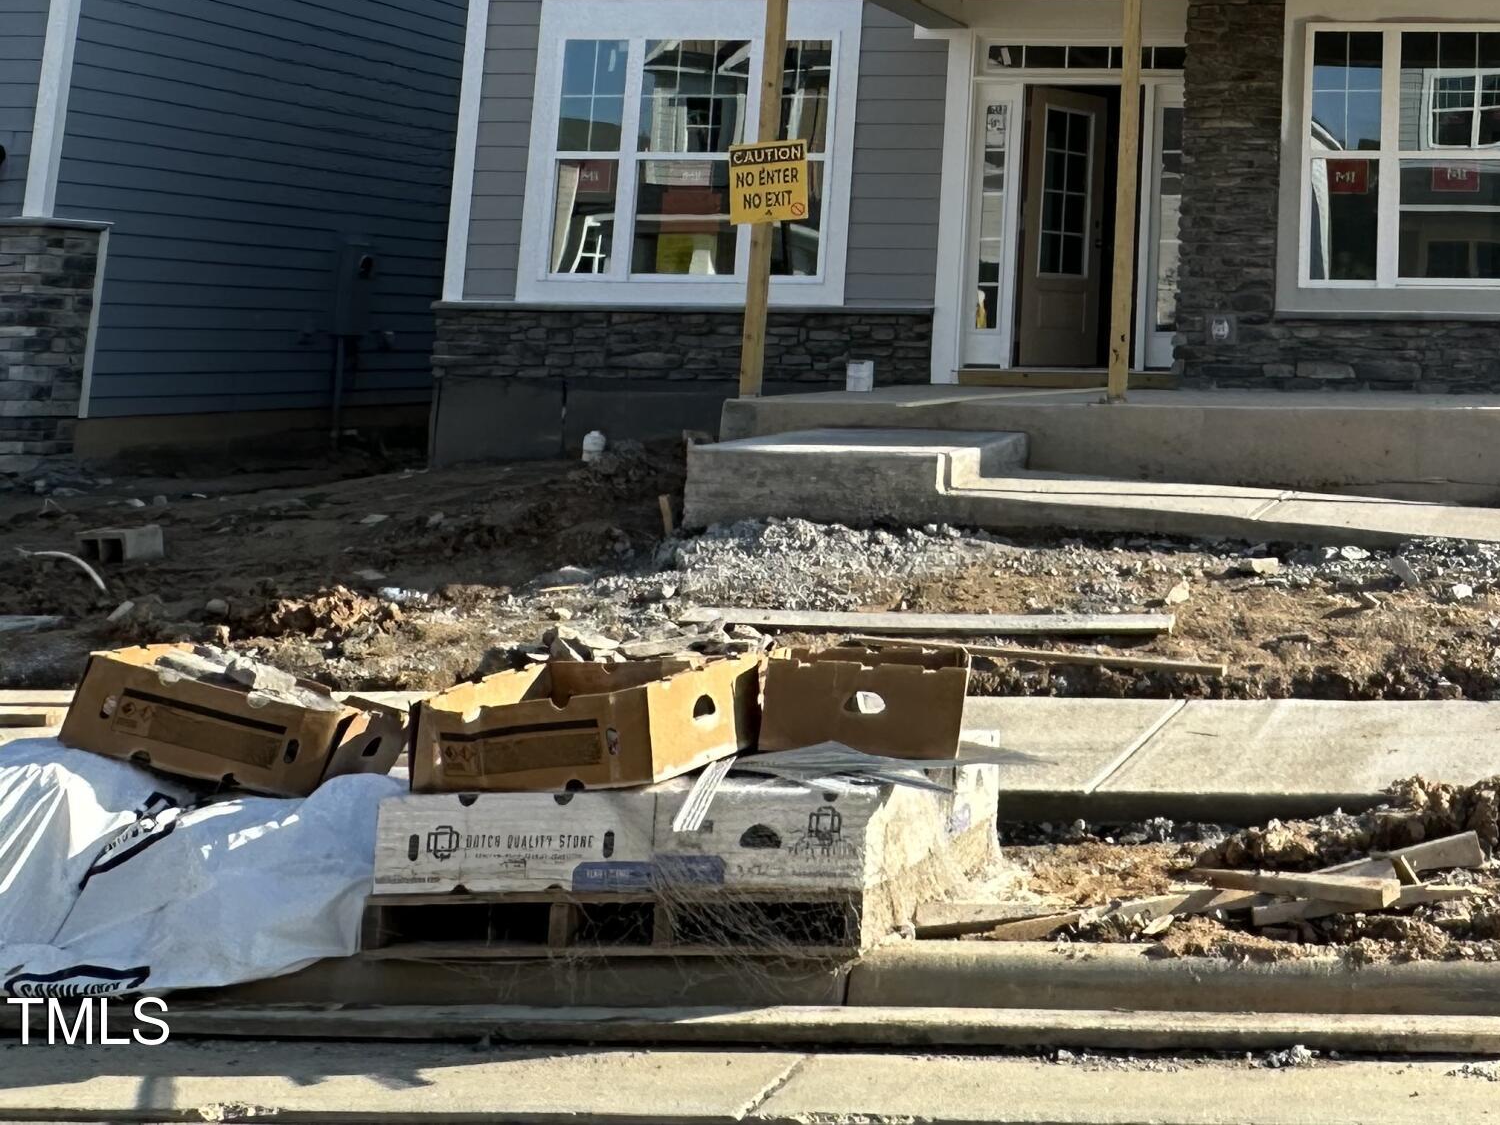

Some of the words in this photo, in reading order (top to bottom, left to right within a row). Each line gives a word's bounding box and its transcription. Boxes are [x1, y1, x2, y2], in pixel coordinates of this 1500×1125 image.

[733, 145, 802, 164] CAUTION
[736, 172, 755, 188] NO
[759, 169, 799, 186] ENTER
[1335, 171, 1356, 183] MI
[743, 193, 762, 210] NO
[765, 190, 793, 207] EXIT
[466, 834, 501, 849] DUTCH
[507, 834, 553, 849] QUALITY
[559, 834, 595, 849] STONE
